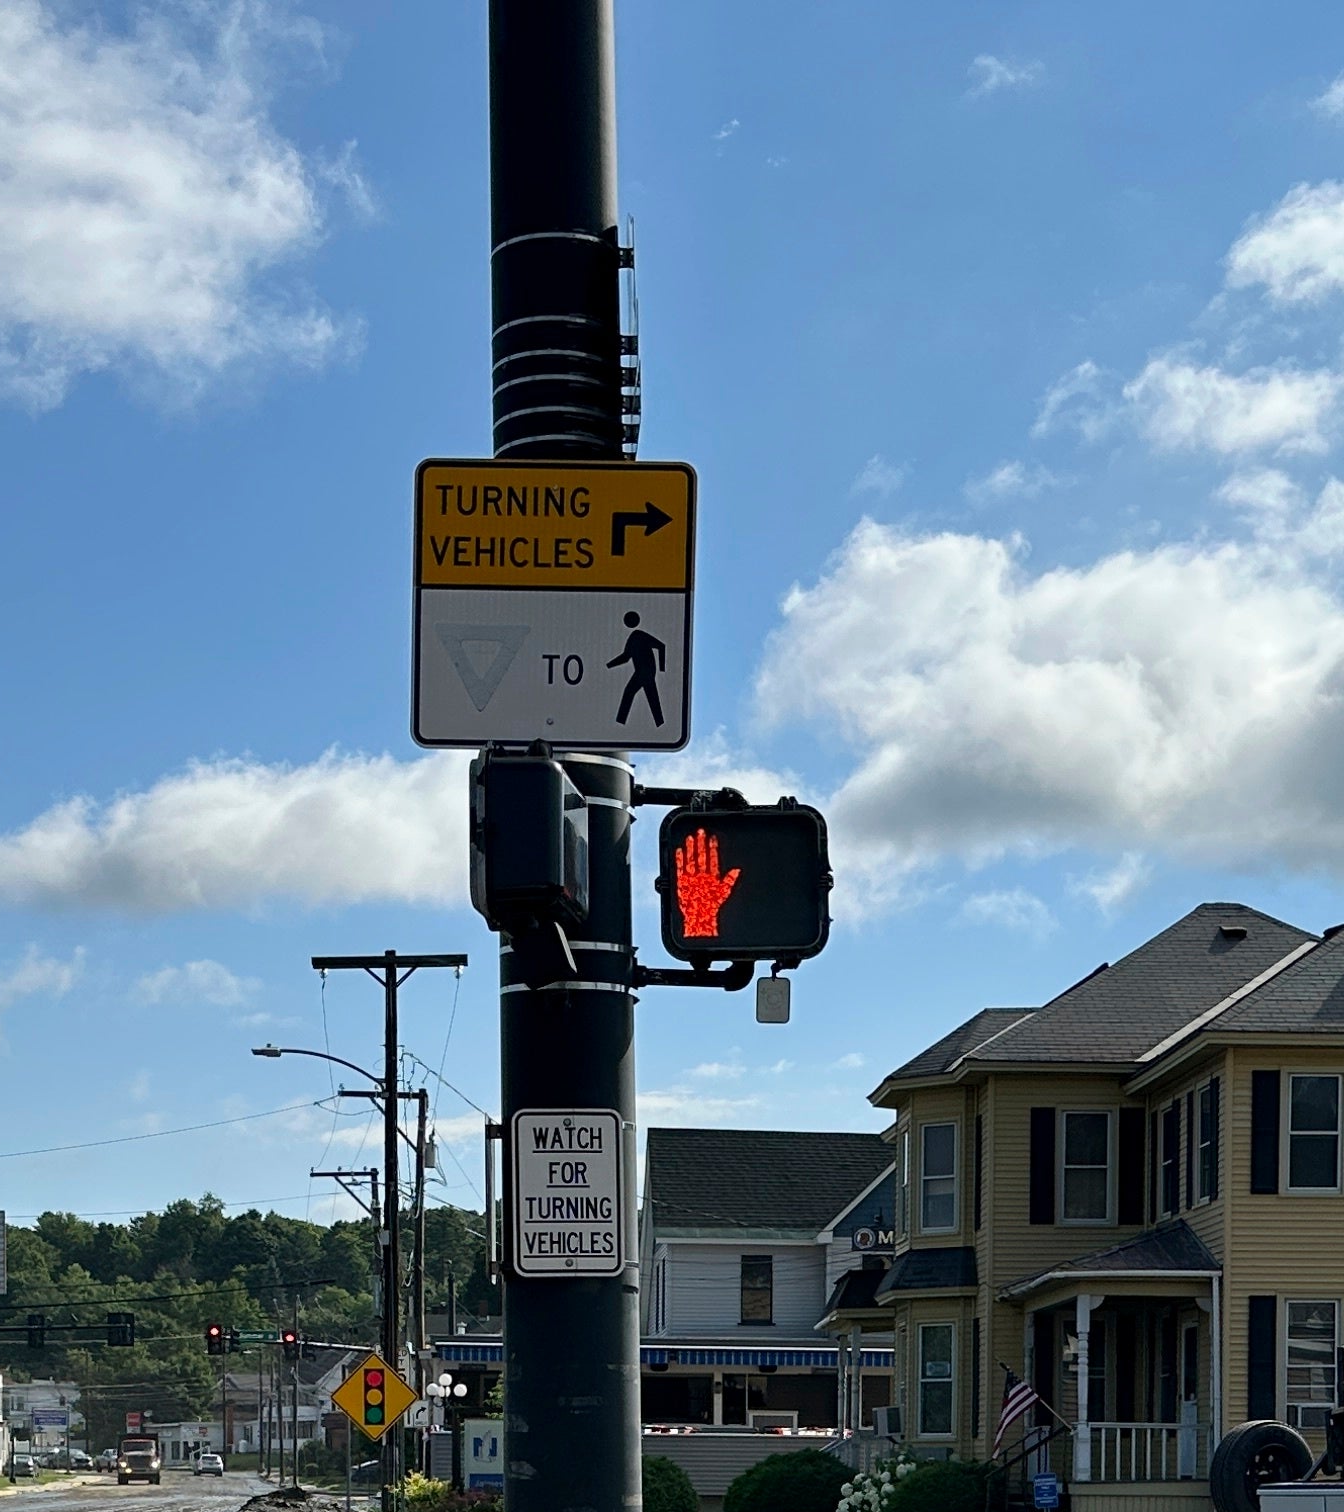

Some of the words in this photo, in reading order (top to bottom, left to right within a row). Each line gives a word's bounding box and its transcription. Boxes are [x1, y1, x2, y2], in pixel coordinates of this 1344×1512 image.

[435, 485, 591, 519] TURNING
[429, 535, 594, 569] VEHICLES
[542, 654, 584, 686] TO
[532, 1127, 603, 1150] WATCH
[548, 1162, 587, 1184] FOR
[525, 1197, 612, 1220] TURNING
[524, 1232, 614, 1254] VEHICLES
